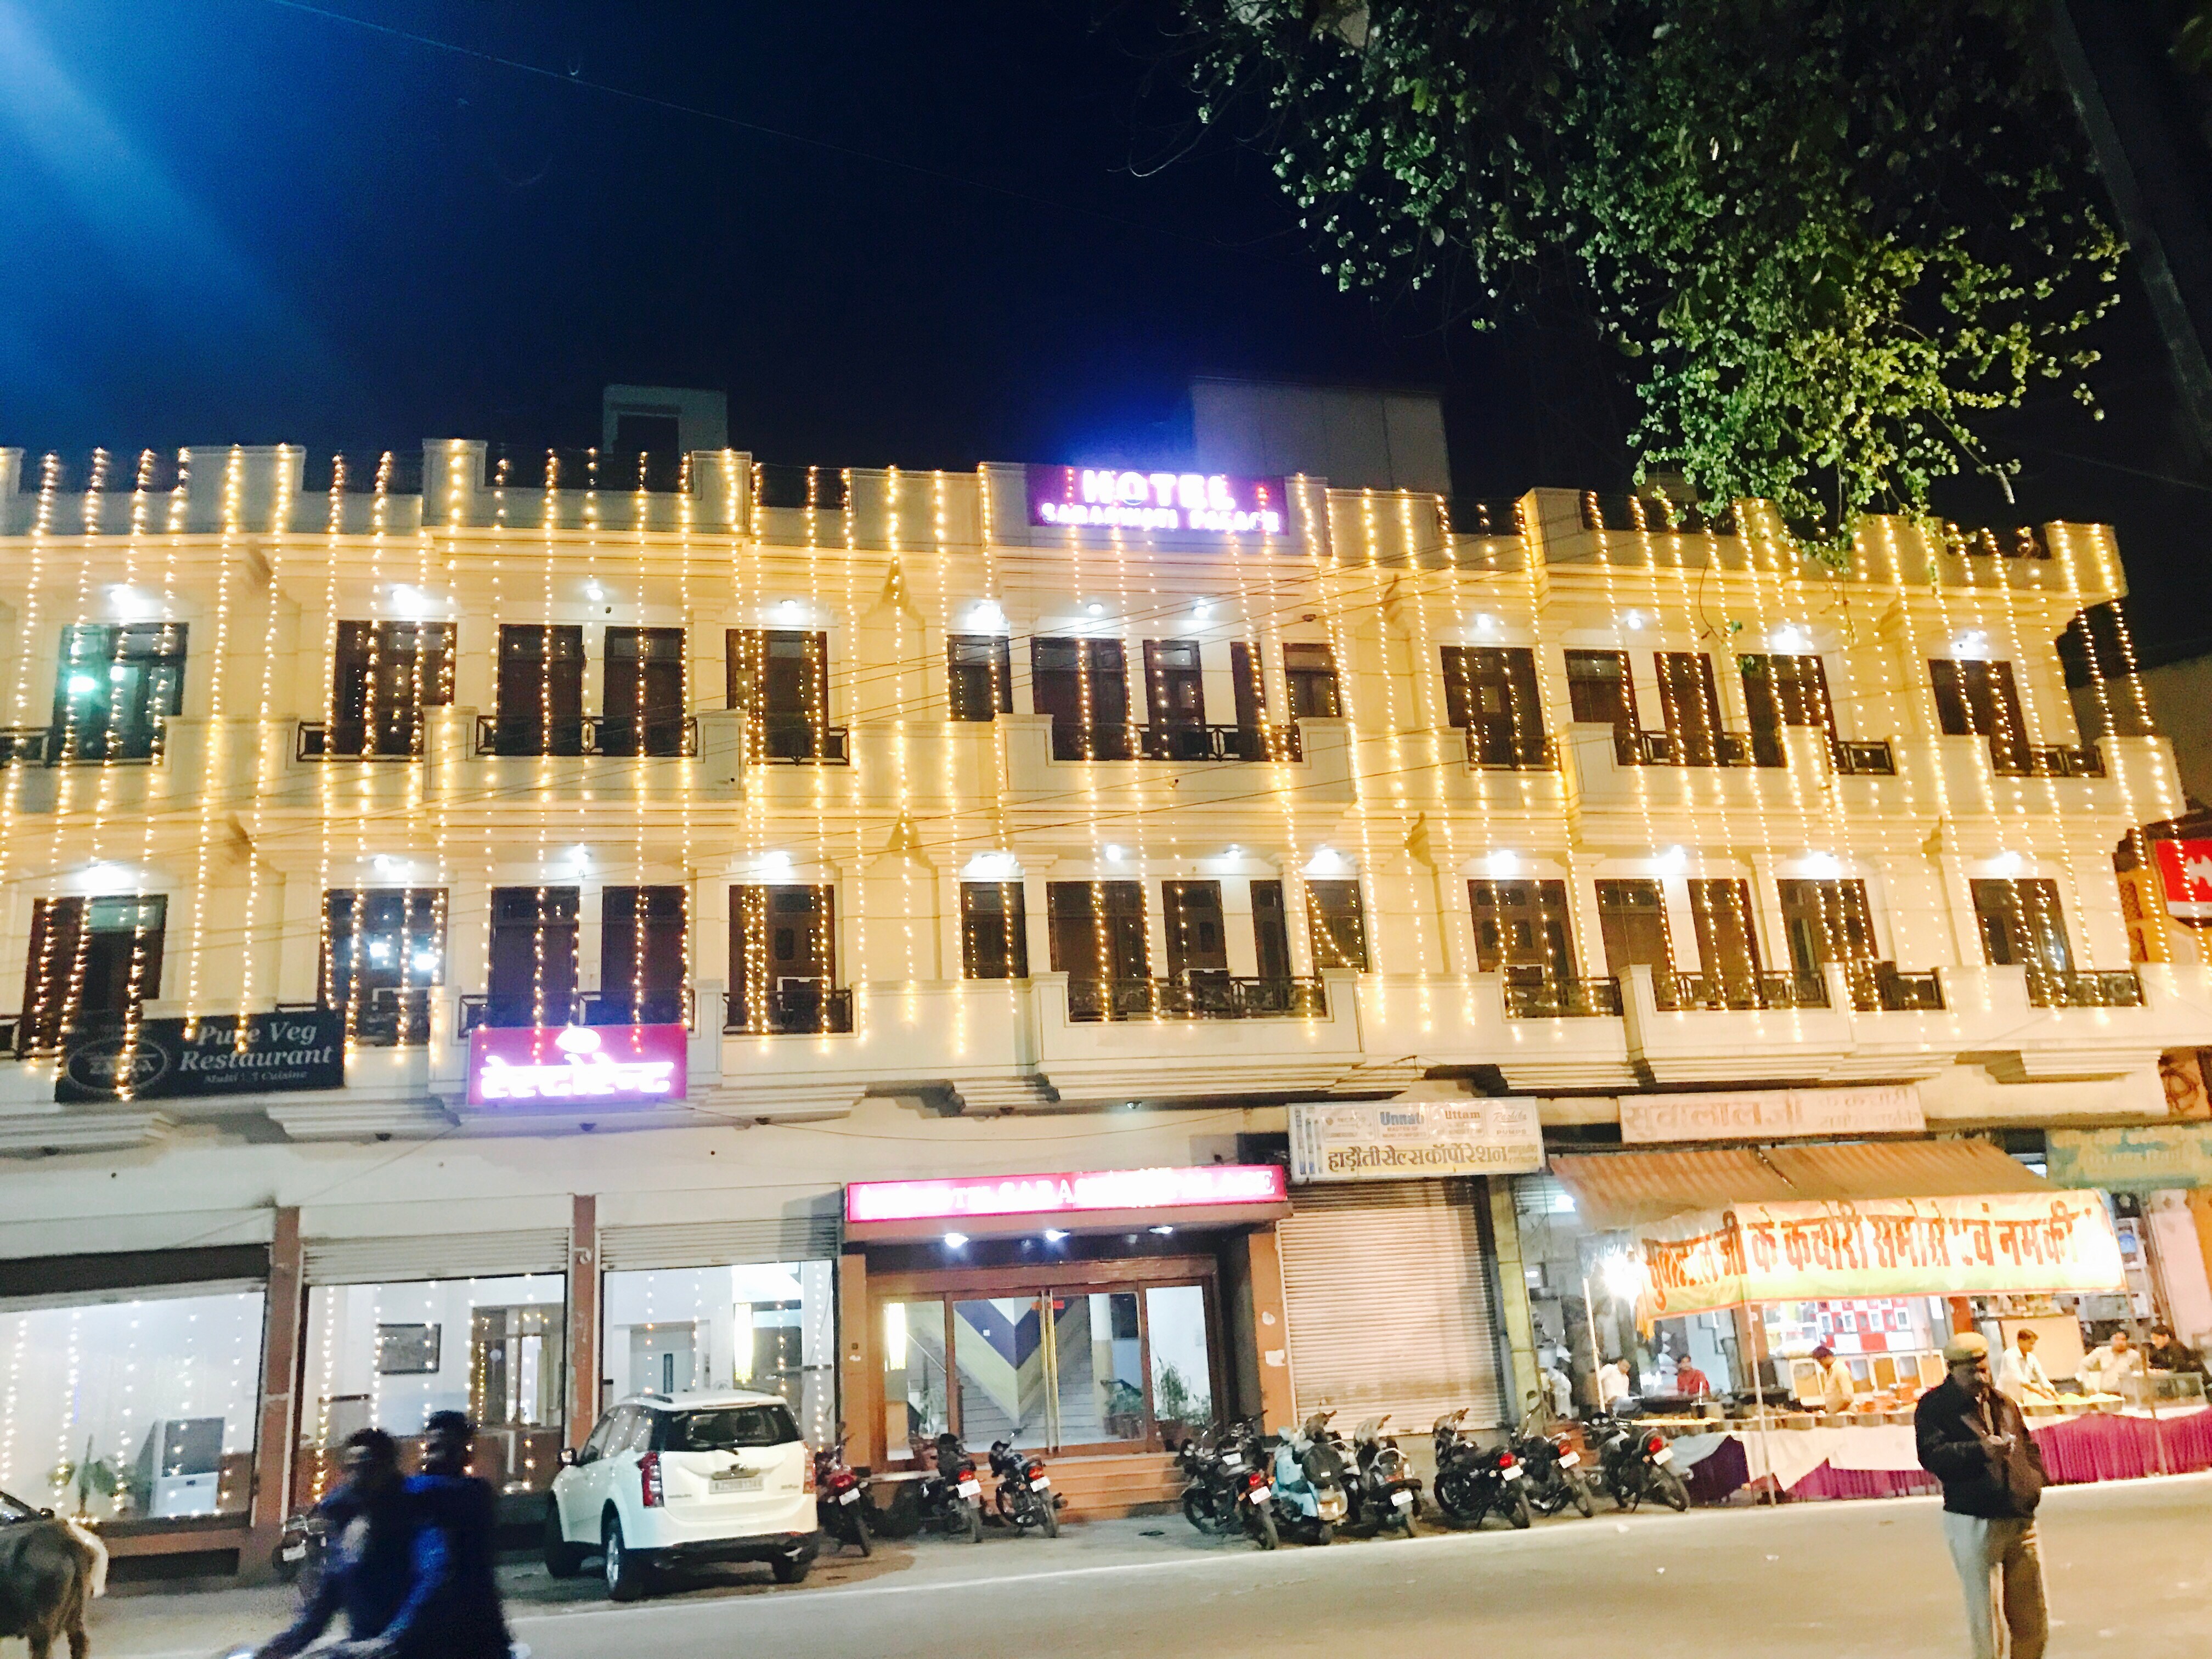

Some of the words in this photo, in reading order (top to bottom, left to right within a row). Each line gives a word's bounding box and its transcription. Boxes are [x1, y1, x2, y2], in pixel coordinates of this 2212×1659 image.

[1083, 470, 1235, 511] HOTEL
[270, 1021, 317, 1045] Veg
[180, 1046, 332, 1071] Restaurant
[1445, 1110, 1481, 1120] Uttam
[1747, 1205, 1778, 1272] के
[1994, 1200, 2092, 1266] नमकी
